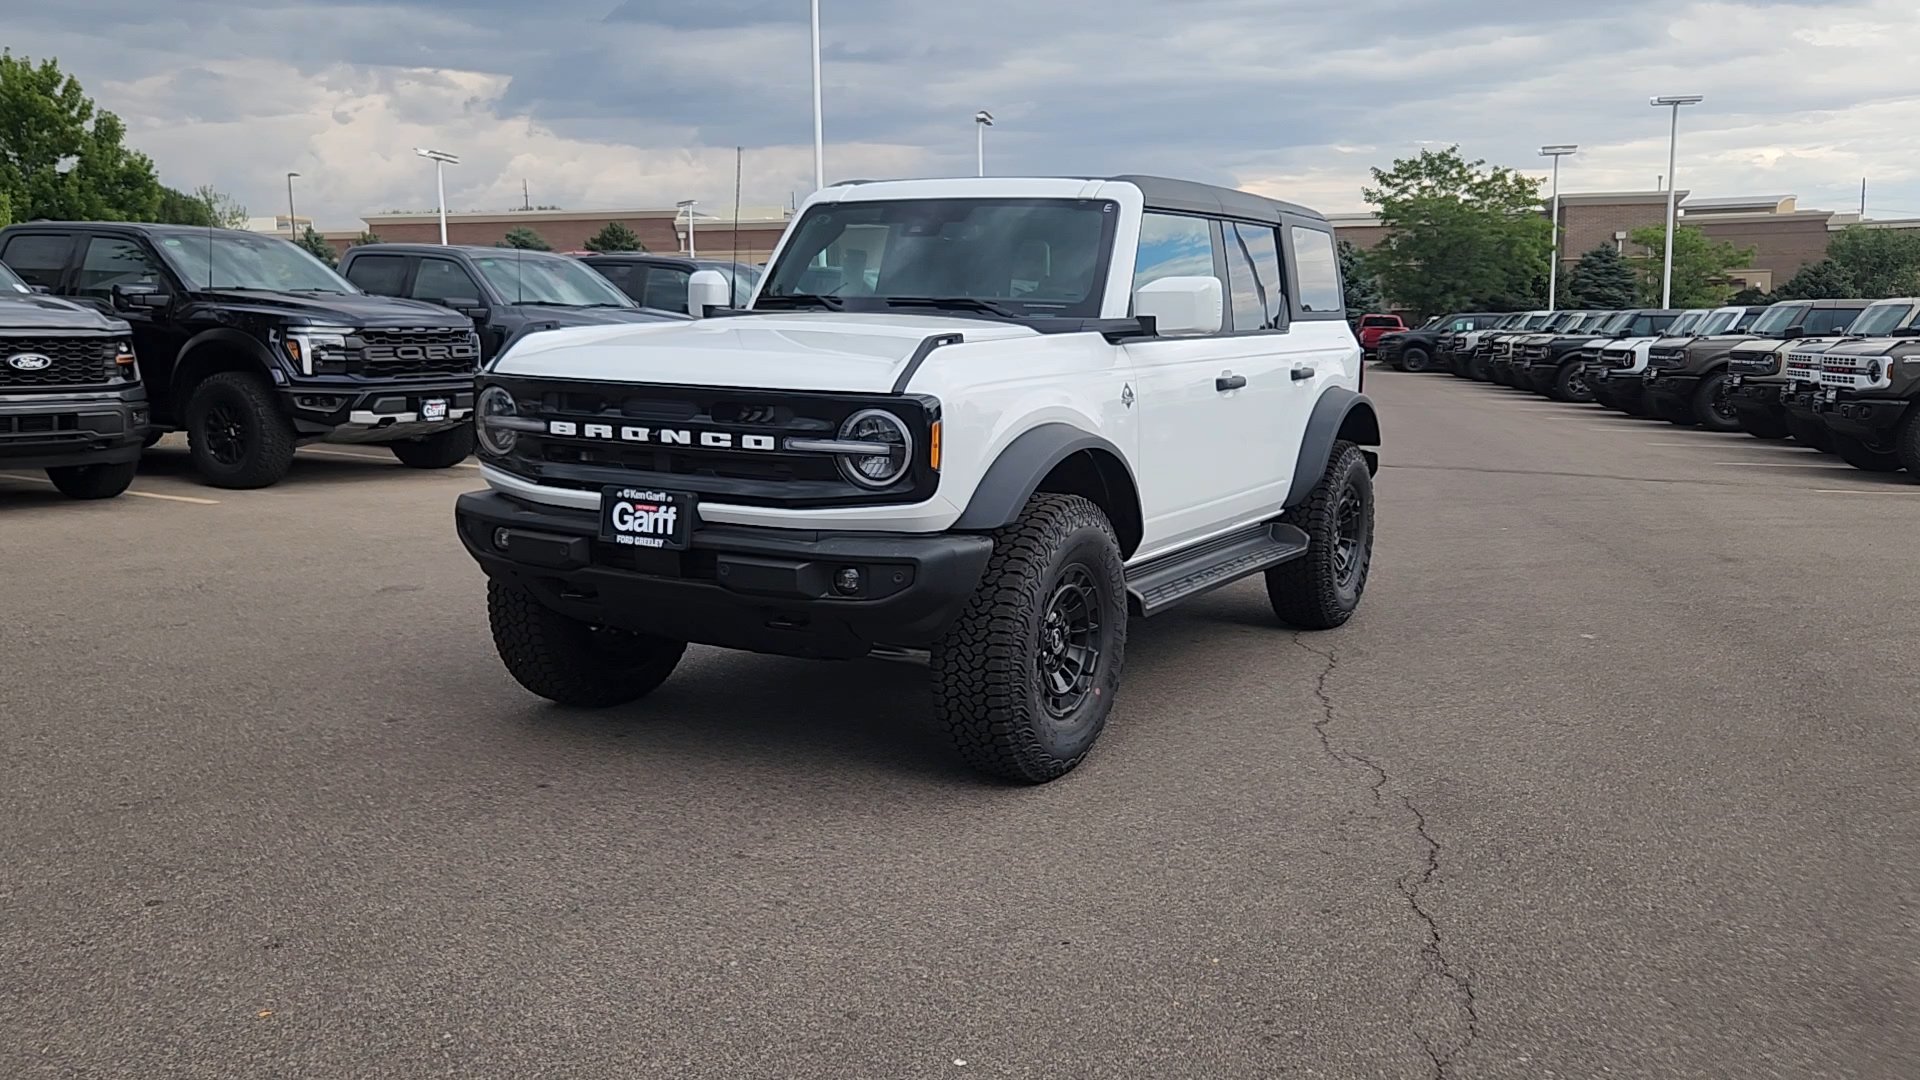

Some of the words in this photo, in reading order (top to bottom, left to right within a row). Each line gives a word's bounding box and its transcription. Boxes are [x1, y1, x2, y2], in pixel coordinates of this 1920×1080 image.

[363, 346, 474, 361] FORD
[550, 421, 775, 450] BRONCO
[630, 489, 646, 500] Ken
[646, 491, 666, 502] Garff
[612, 501, 677, 535] Garff
[616, 535, 634, 544] FORD
